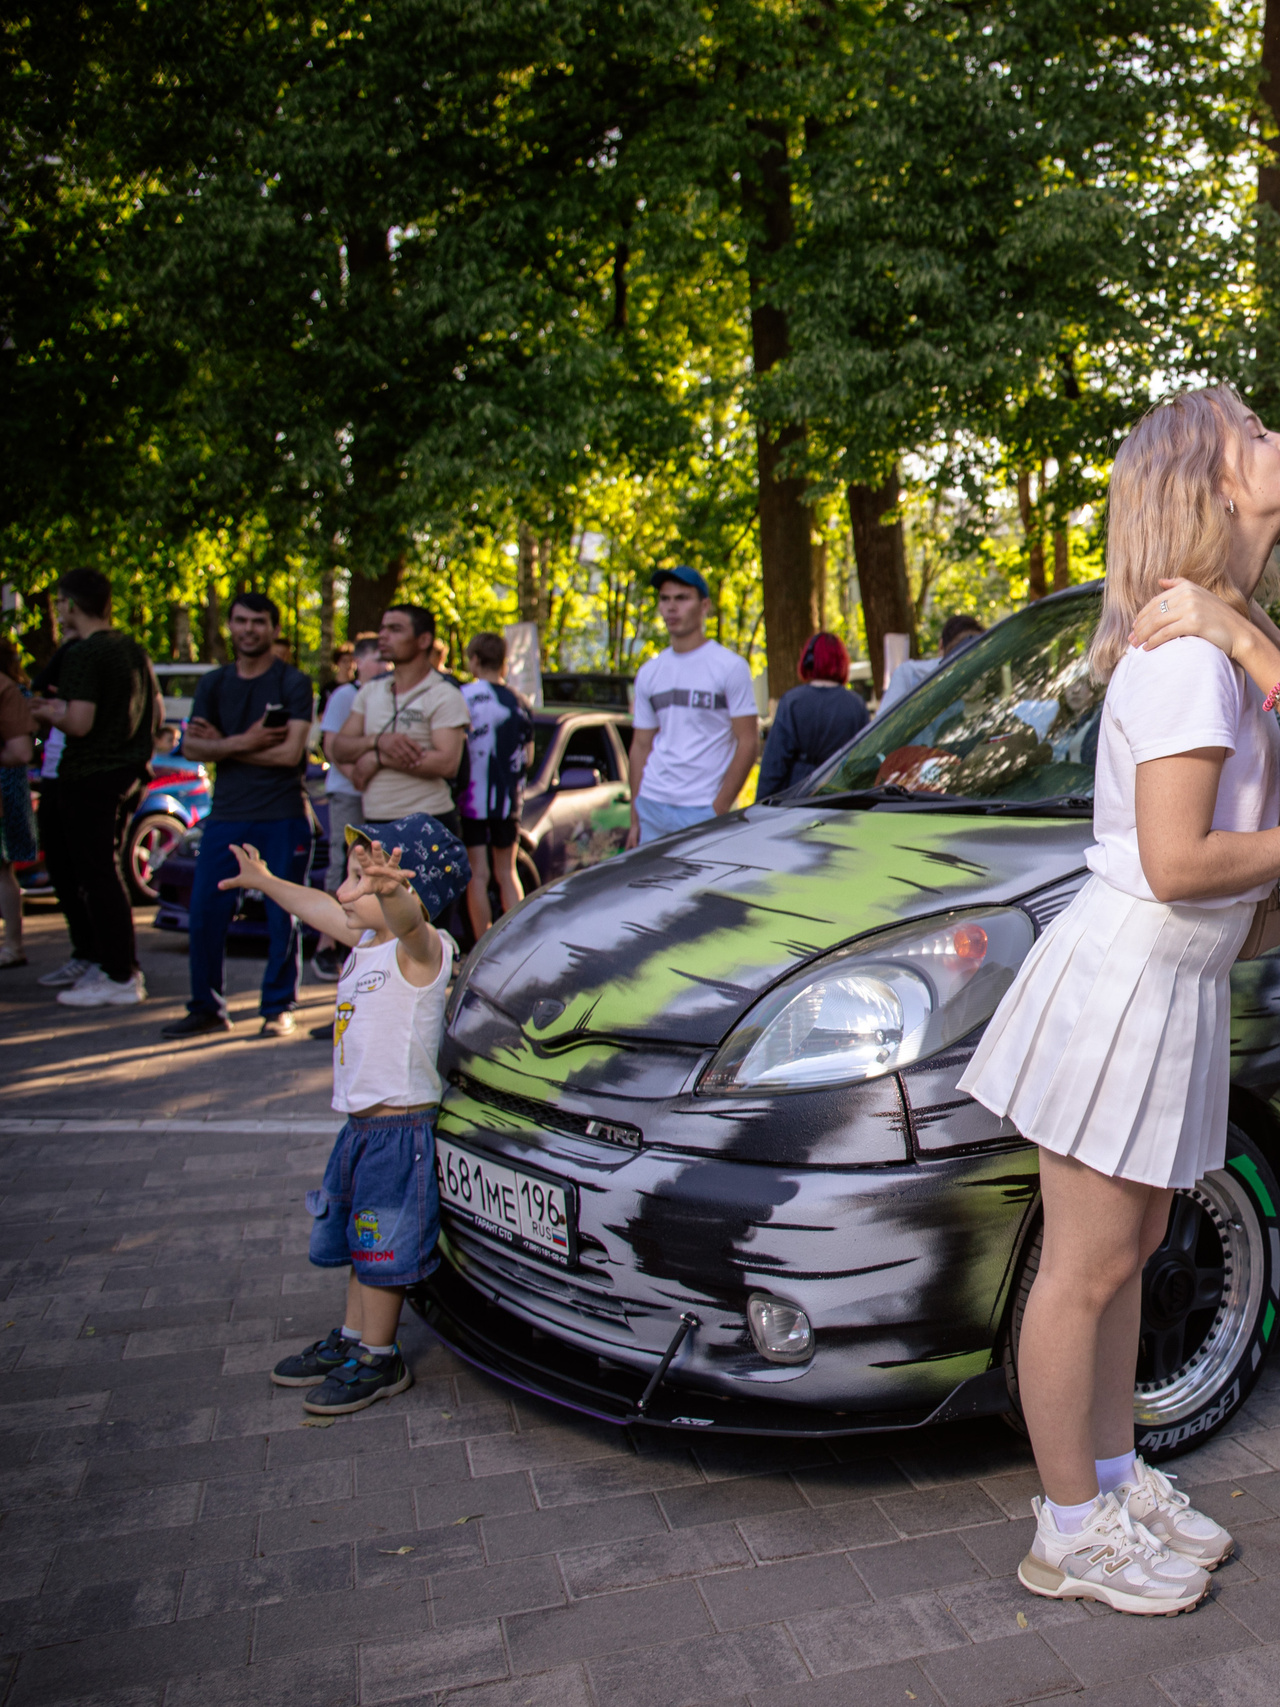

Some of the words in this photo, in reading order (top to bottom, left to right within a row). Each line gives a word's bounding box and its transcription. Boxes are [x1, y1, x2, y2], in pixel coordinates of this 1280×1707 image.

[521, 1180, 561, 1226] 196
[532, 1220, 552, 1241] RUS
[1138, 1378, 1240, 1452] GReddy
